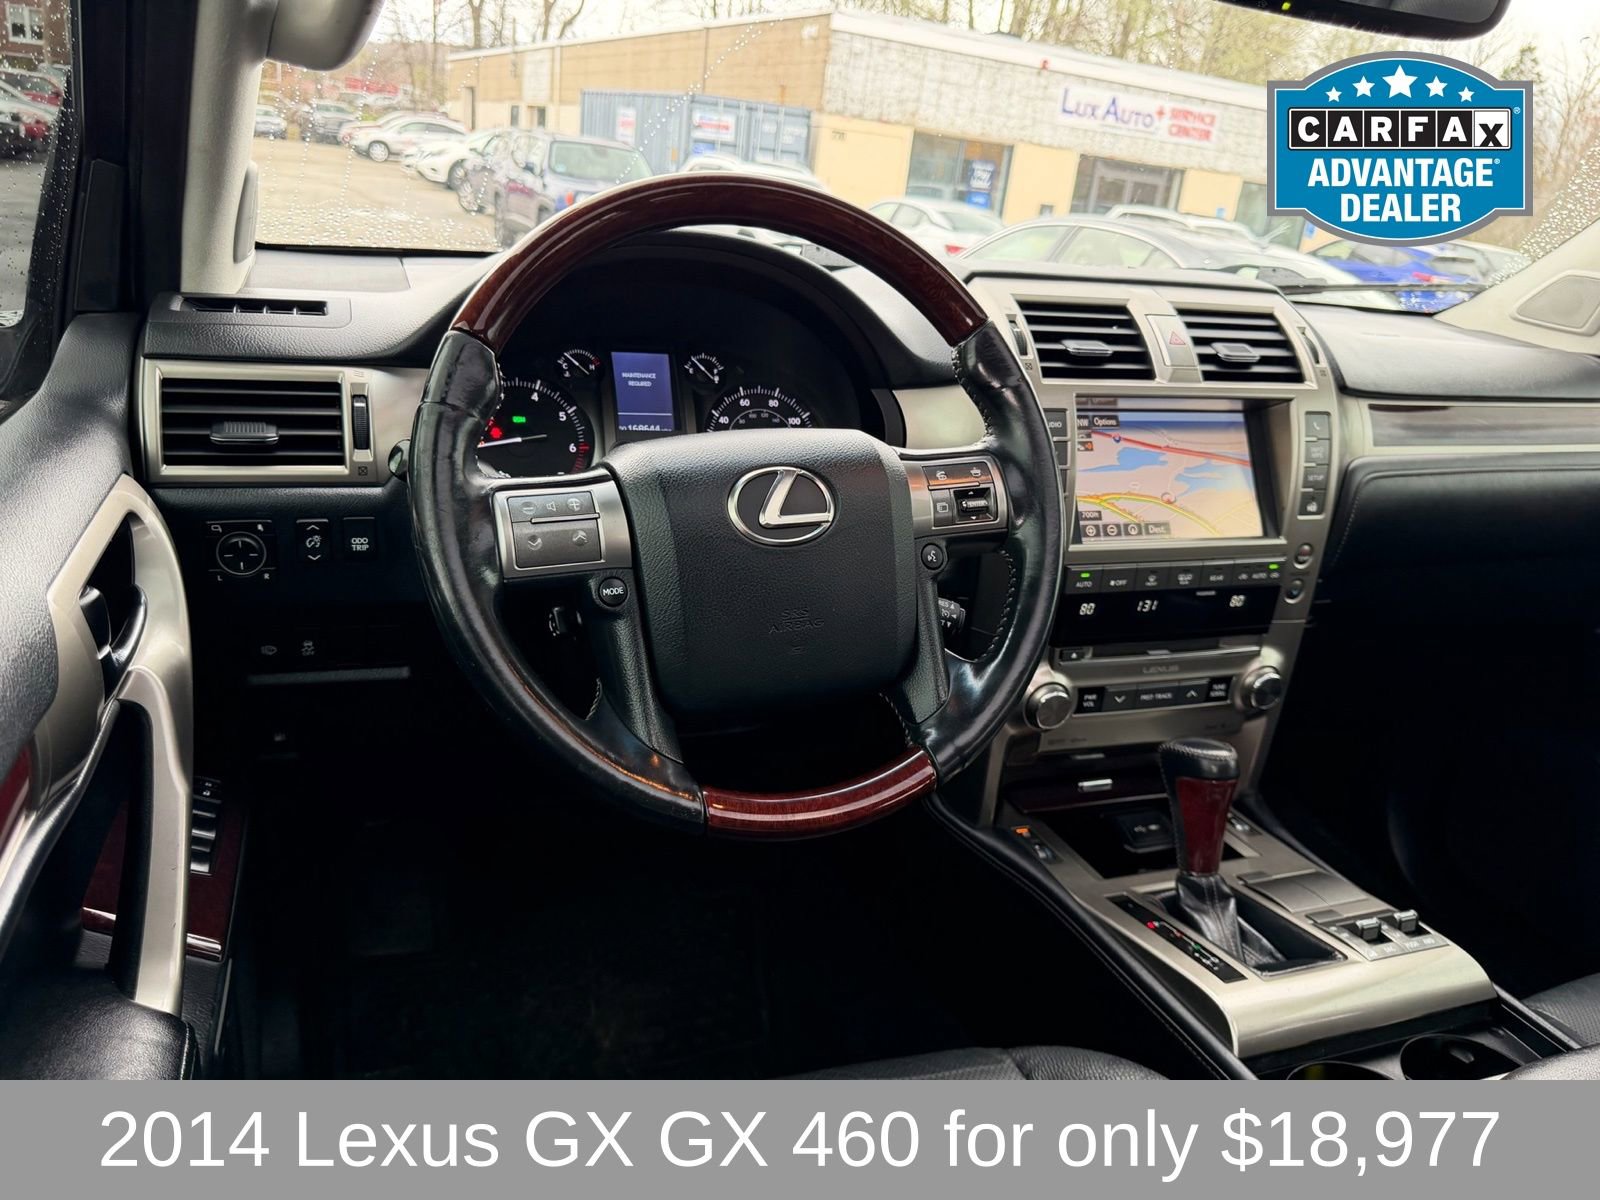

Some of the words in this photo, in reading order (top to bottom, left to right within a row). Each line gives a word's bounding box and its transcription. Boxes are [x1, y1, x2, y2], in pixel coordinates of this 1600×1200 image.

[531, 392, 539, 401] 4
[739, 399, 750, 407] 60
[768, 399, 779, 407] 80
[559, 411, 567, 421] 5
[718, 416, 729, 424] 40
[788, 417, 801, 425] 100
[1093, 417, 1117, 426] Options
[569, 443, 577, 453] 6
[602, 587, 624, 596] MODE
[1229, 594, 1246, 608] 80
[1079, 602, 1096, 616] 80
[1142, 665, 1180, 674] LEXUS
